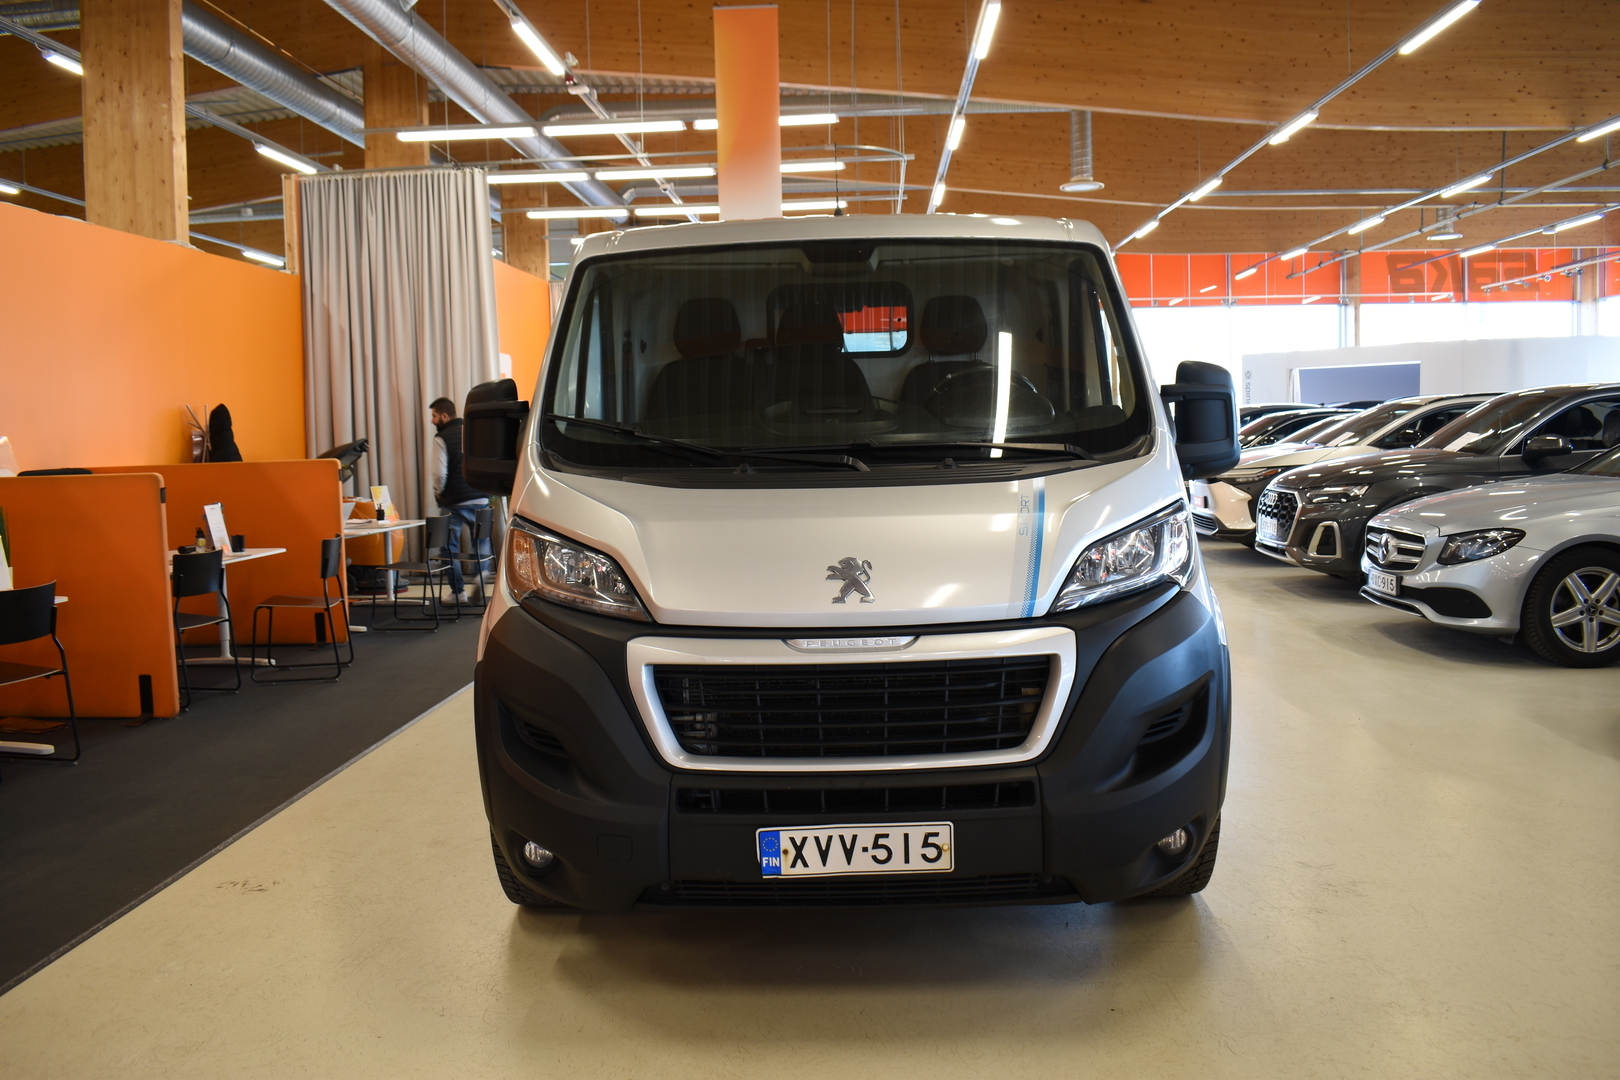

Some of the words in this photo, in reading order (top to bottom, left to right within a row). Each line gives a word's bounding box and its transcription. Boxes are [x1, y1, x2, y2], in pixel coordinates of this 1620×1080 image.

[1018, 494, 1030, 536] SPORT
[804, 638, 897, 648] PEUGEOT
[762, 857, 780, 867] FIN
[788, 832, 943, 869] XVV-515
